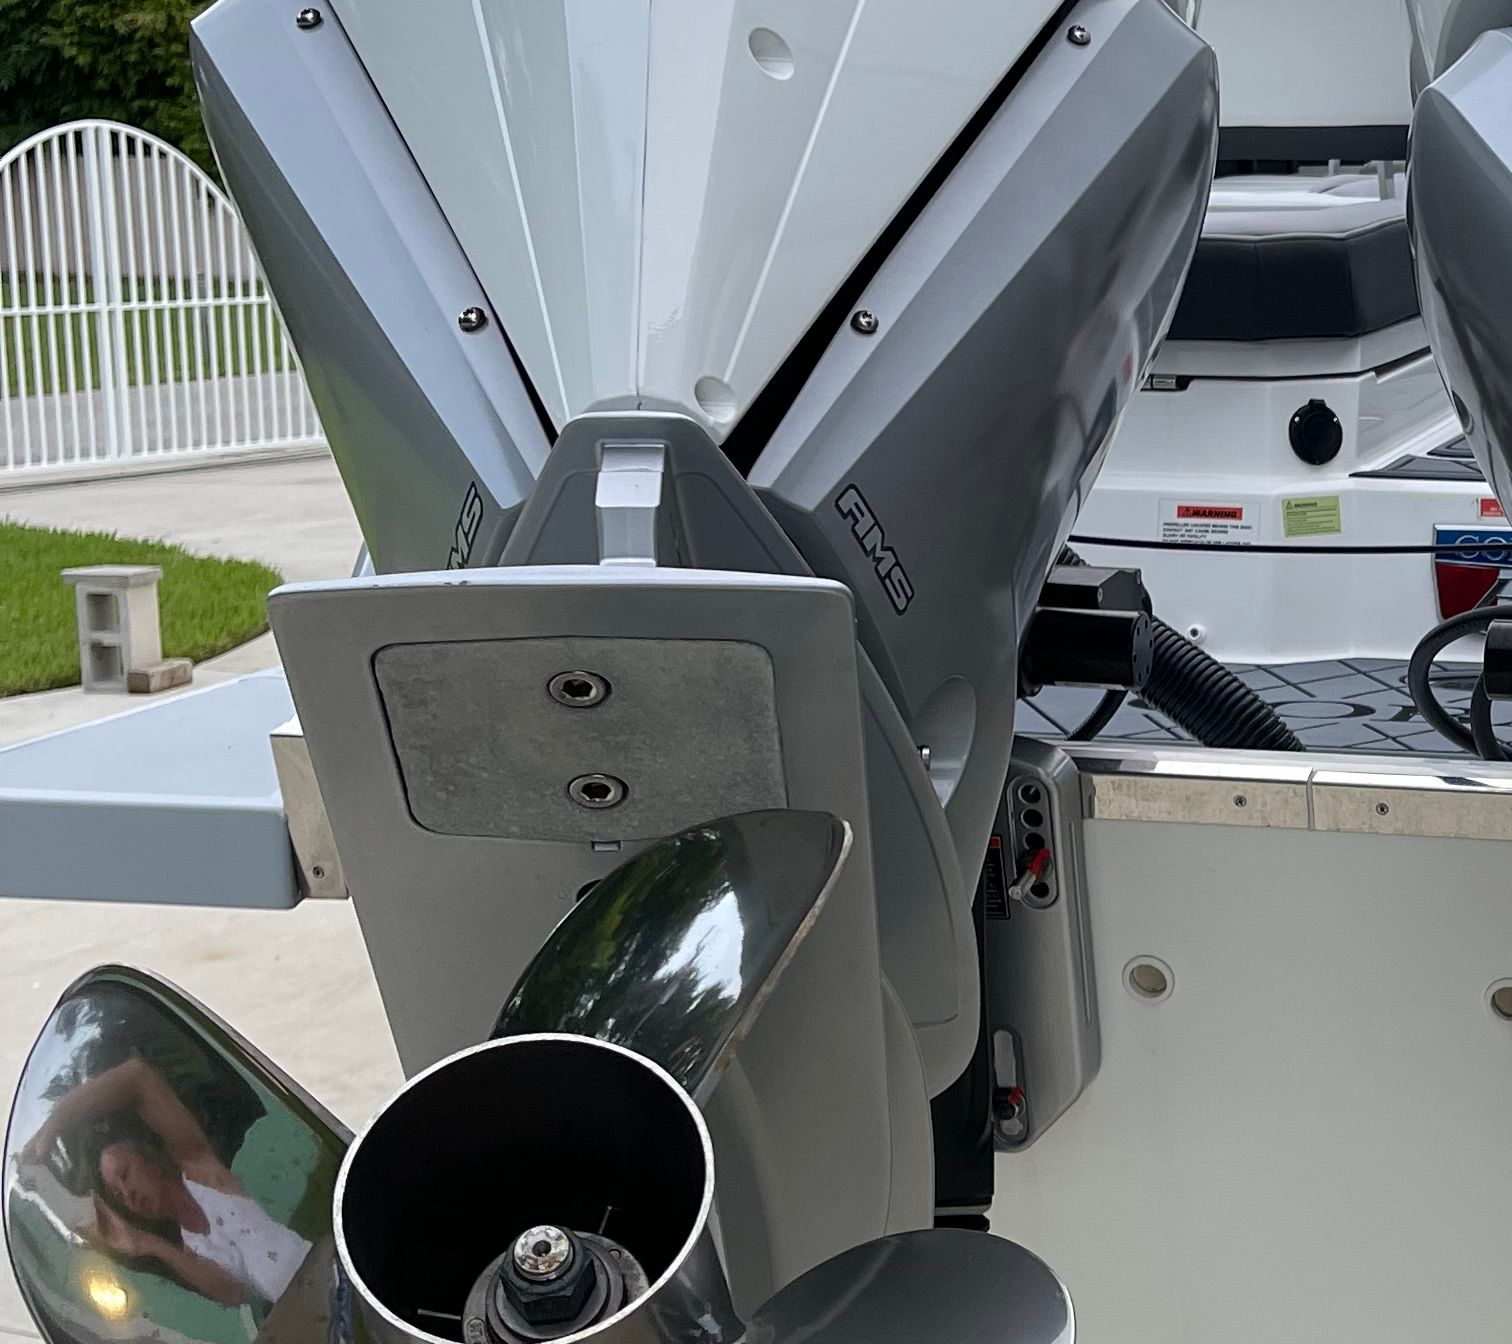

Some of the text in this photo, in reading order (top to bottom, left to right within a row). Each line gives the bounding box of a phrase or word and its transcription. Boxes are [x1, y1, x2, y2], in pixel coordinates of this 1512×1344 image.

[446, 481, 484, 570] MS
[835, 483, 915, 616] AMS
[1191, 508, 1238, 519] WARNING
